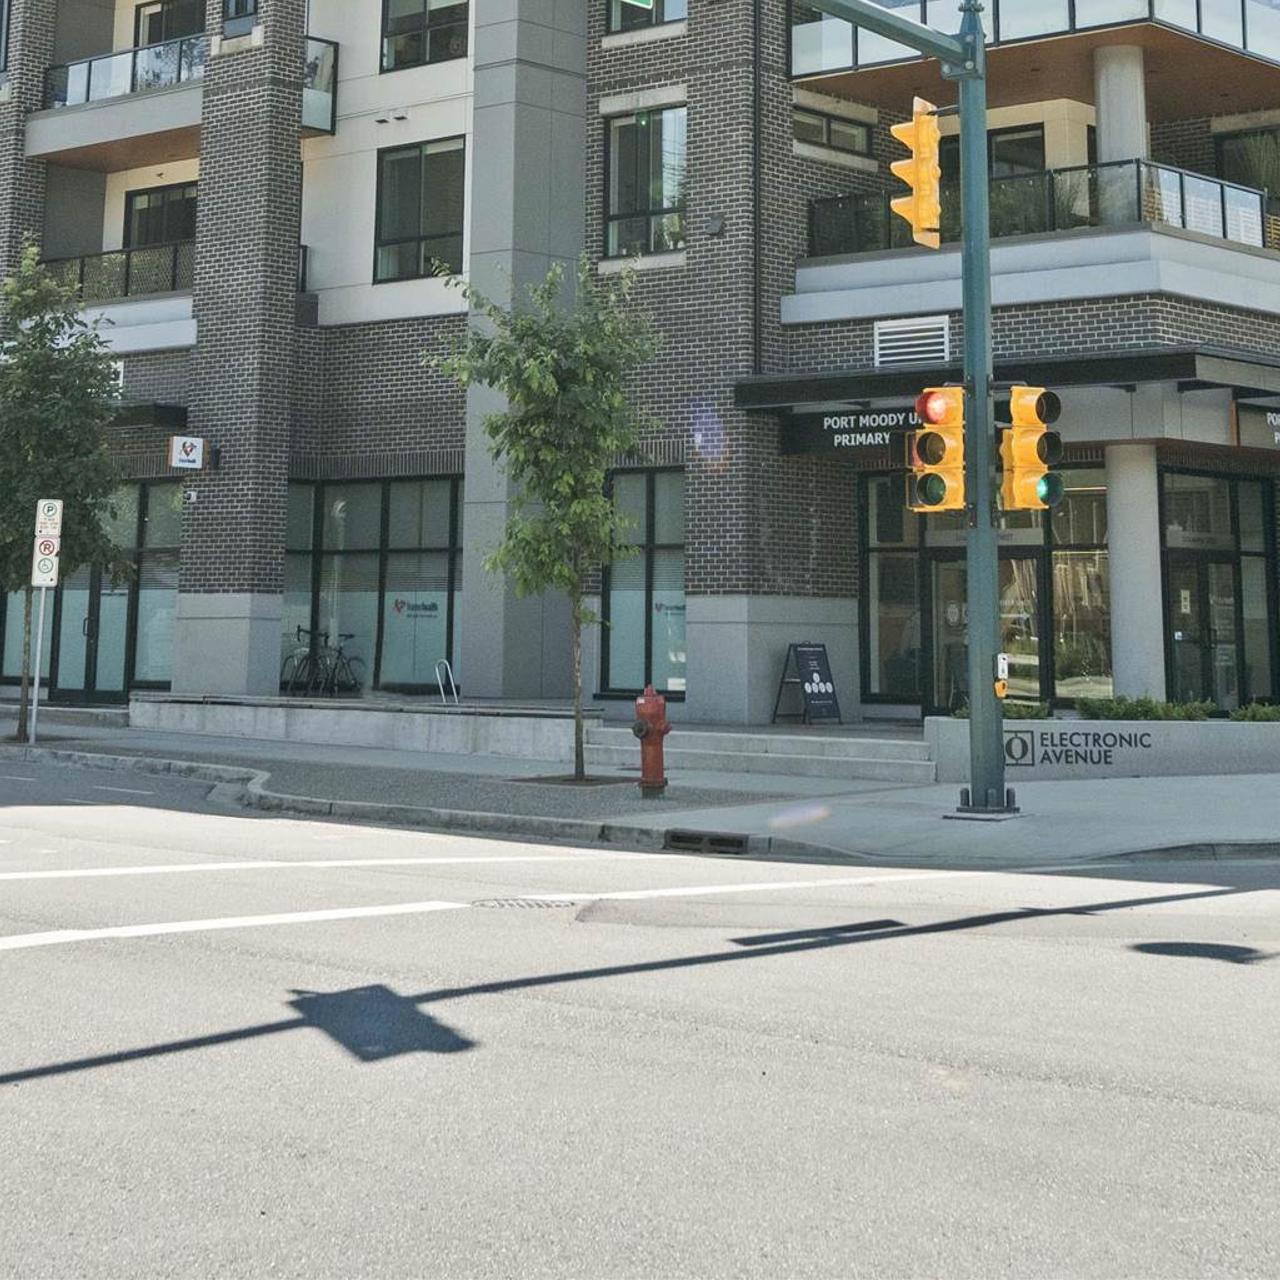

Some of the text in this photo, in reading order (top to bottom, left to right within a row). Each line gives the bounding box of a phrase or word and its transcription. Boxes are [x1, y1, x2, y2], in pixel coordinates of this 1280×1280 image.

[823, 415, 856, 430] PORT
[859, 413, 905, 428] MOODY
[833, 432, 891, 447] PRIMARY
[1039, 732, 1152, 748] ELECTRONIC
[1039, 749, 1113, 765] AVENUE
